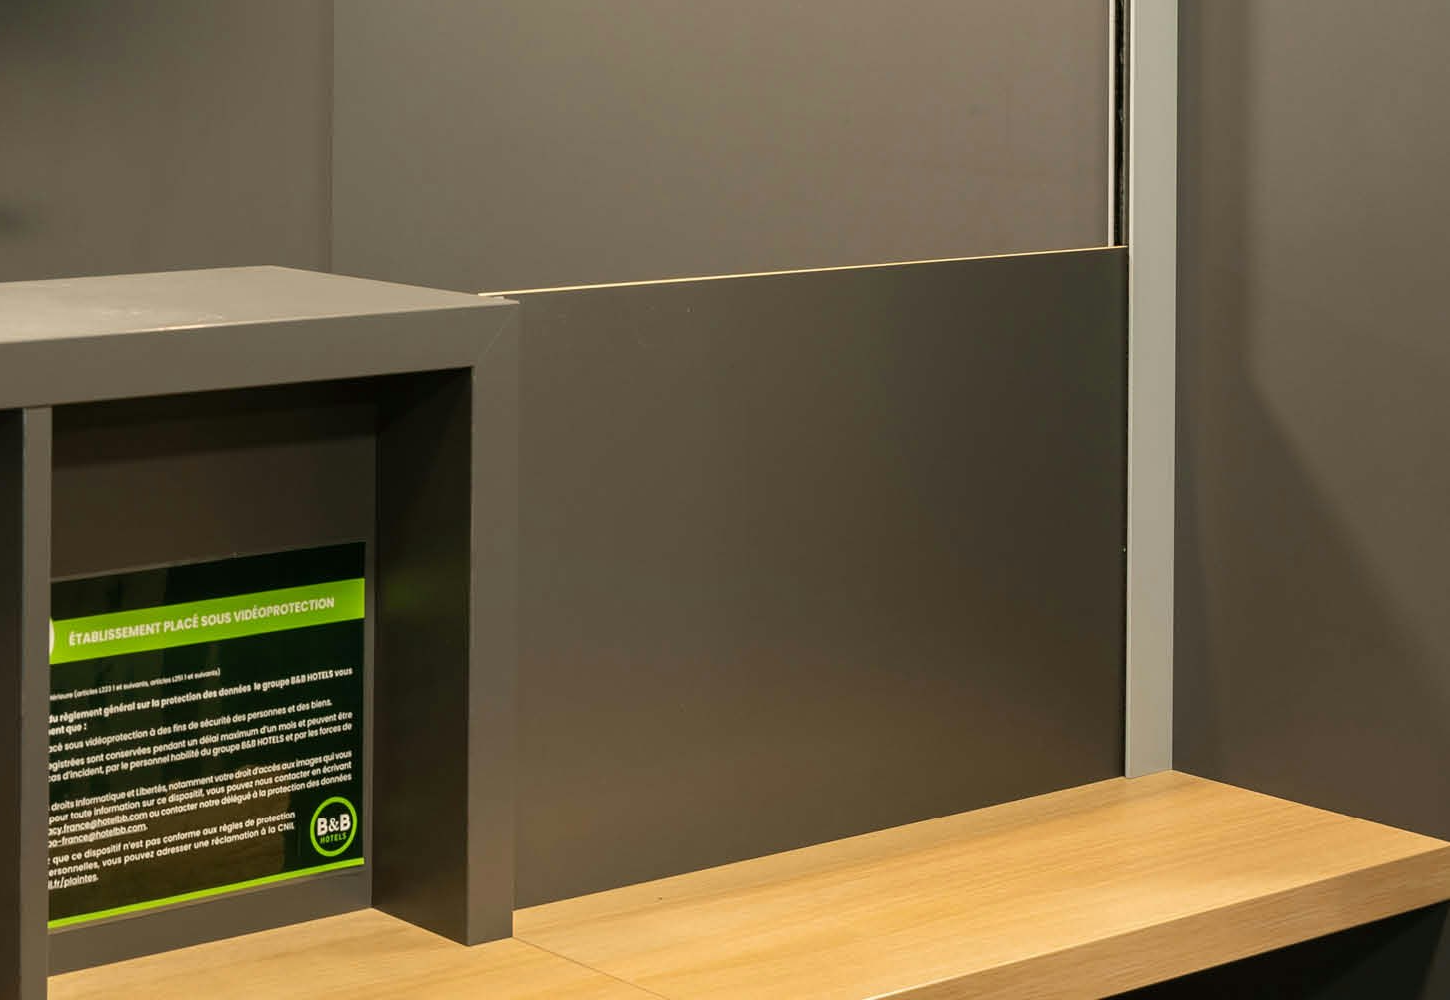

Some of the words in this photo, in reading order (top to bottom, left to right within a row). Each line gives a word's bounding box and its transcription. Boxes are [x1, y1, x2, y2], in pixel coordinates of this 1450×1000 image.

[68, 621, 160, 646] ÉTABLISSEMENT
[163, 613, 198, 632] PLACÉ
[201, 611, 231, 626] SOUS
[233, 597, 334, 622] VIDÉOPROTECTION
[60, 706, 101, 722] règlement
[104, 701, 135, 716] général
[137, 701, 150, 709] sur
[152, 698, 159, 707] la
[161, 692, 201, 707] protection
[203, 689, 217, 699] des
[219, 684, 250, 696] données
[254, 681, 260, 690] le
[262, 678, 289, 691] groupe
[290, 674, 306, 684] B&B
[307, 669, 333, 682] HOTELS
[335, 668, 352, 677] vous
[64, 741, 83, 750] sous
[85, 729, 148, 747] vidéoprotection
[149, 727, 155, 736] à
[157, 726, 171, 735] des
[173, 723, 186, 732] fins
[188, 721, 198, 729] de
[200, 714, 231, 727] sécurité
[232, 713, 245, 722] des
[247, 707, 285, 722] personnes
[288, 704, 295, 713] et
[296, 703, 309, 711] des
[52, 855, 69, 865] que
[71, 852, 81, 860] ce
[84, 843, 120, 857] dispositif
[123, 839, 143, 850] n'est
[145, 837, 160, 847] pas
[163, 830, 200, 842] conforme
[203, 827, 217, 835] aux
[219, 822, 242, 833] règles
[245, 819, 254, 827] de
[256, 812, 295, 827] protection
[102, 857, 121, 866] vous
[124, 851, 154, 864] pouvez
[156, 843, 191, 856] adresser
[194, 840, 208, 849] une
[211, 830, 258, 845] réclamation
[260, 827, 266, 835] à
[268, 826, 275, 834] la
[317, 812, 351, 836] B&B
[319, 832, 346, 844] HOTELS
